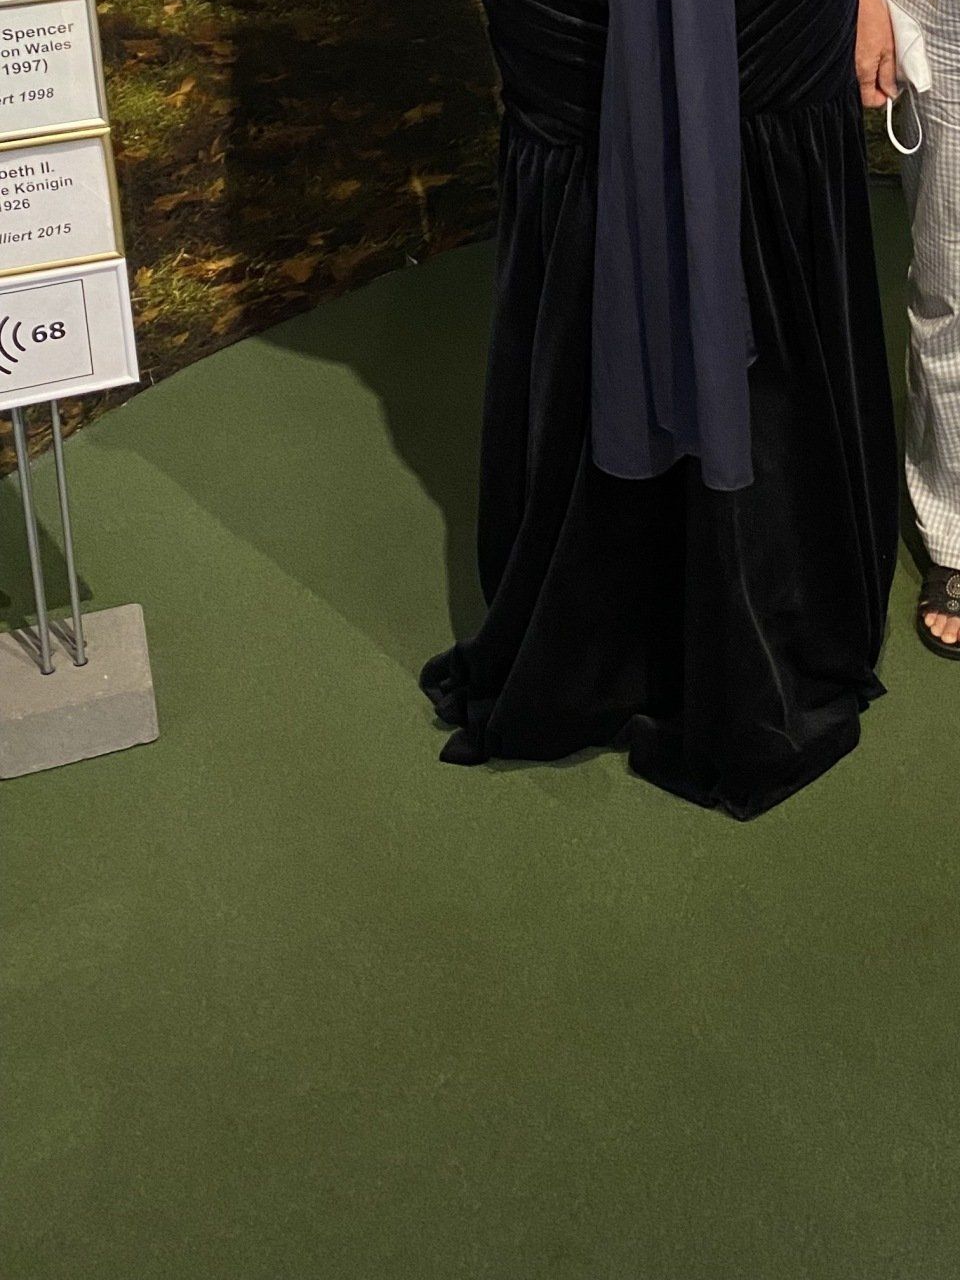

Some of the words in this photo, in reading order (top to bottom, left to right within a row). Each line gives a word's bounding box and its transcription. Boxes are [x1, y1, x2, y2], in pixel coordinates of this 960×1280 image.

[1, 22, 75, 42] Spencer
[25, 40, 72, 55] Wales
[1, 58, 49, 75] 1997)
[19, 87, 54, 102] 1998
[40, 161, 55, 174] II.
[14, 176, 73, 195] Königin
[37, 222, 72, 239] 2015
[31, 321, 66, 343] 68
